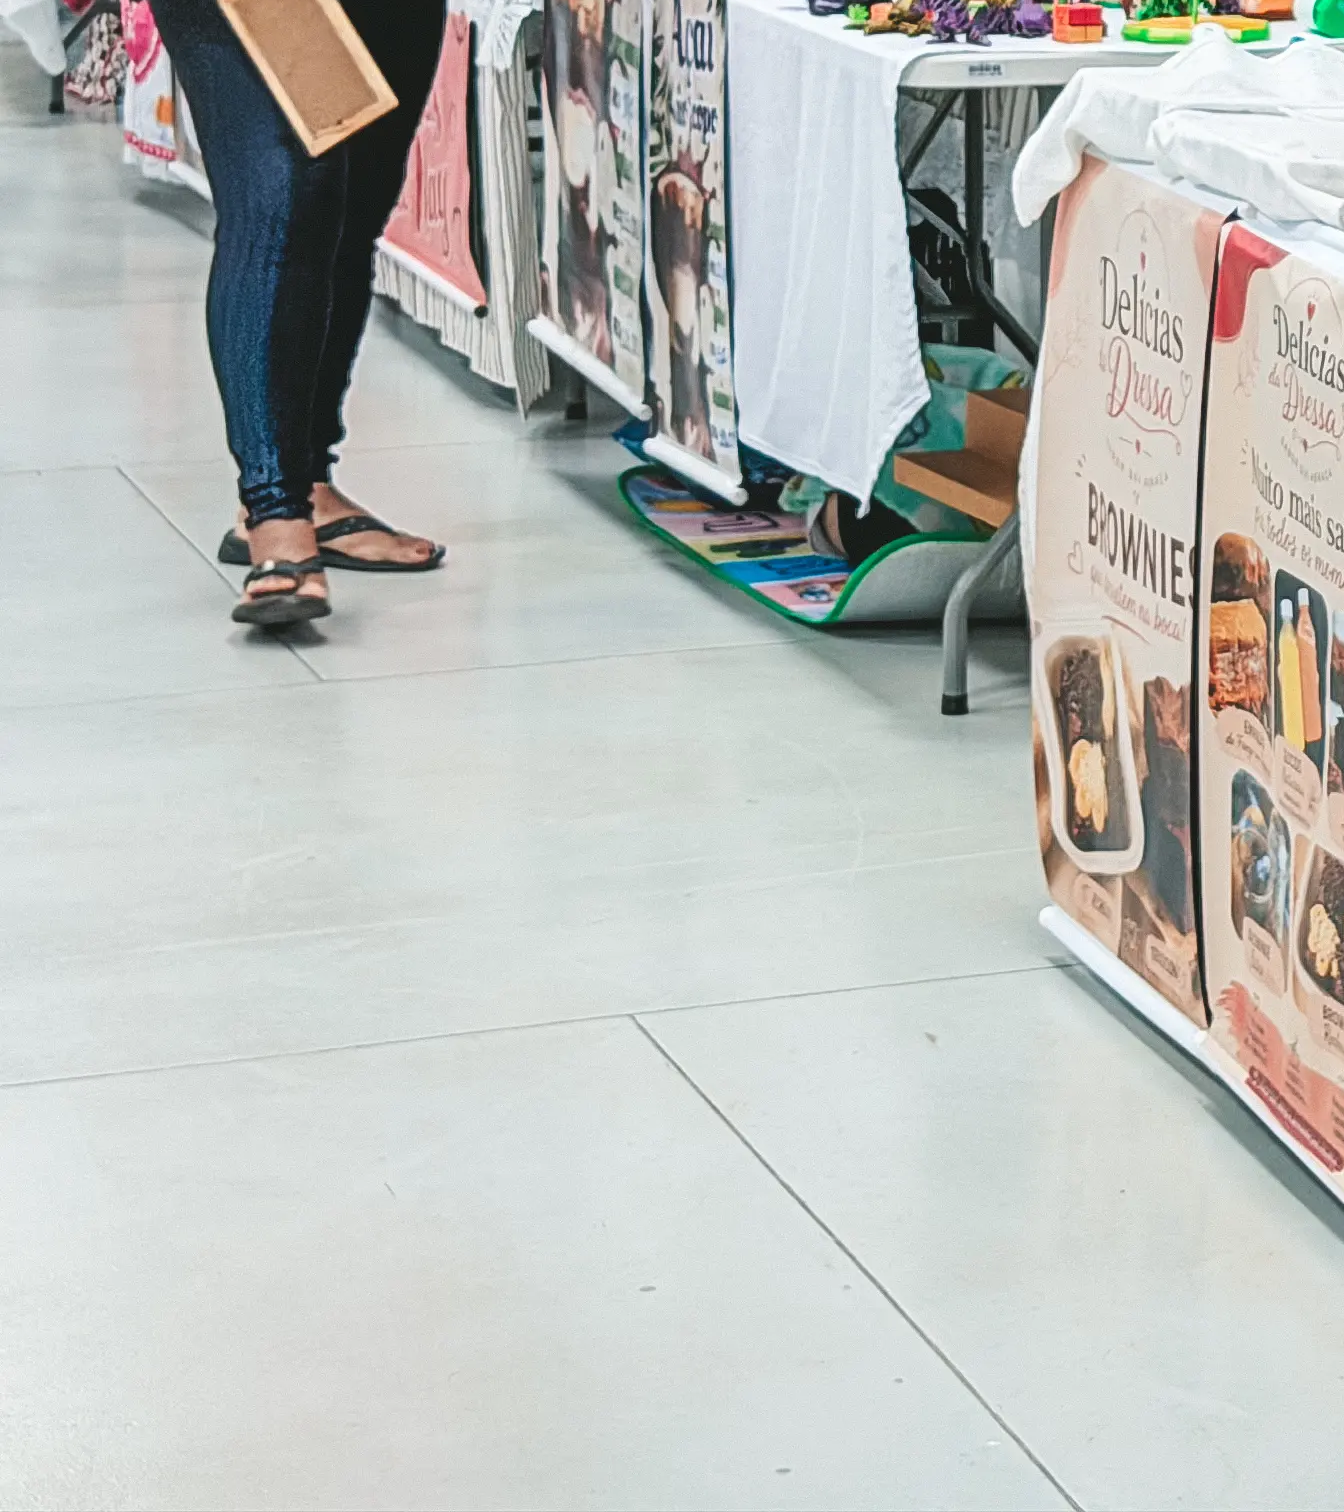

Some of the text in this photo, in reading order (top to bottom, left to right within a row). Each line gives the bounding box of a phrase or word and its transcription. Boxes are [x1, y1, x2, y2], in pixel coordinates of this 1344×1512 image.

[1099, 255, 1185, 364] Delícias
[1106, 336, 1188, 426] Dressa
[1288, 489, 1322, 539] mais
